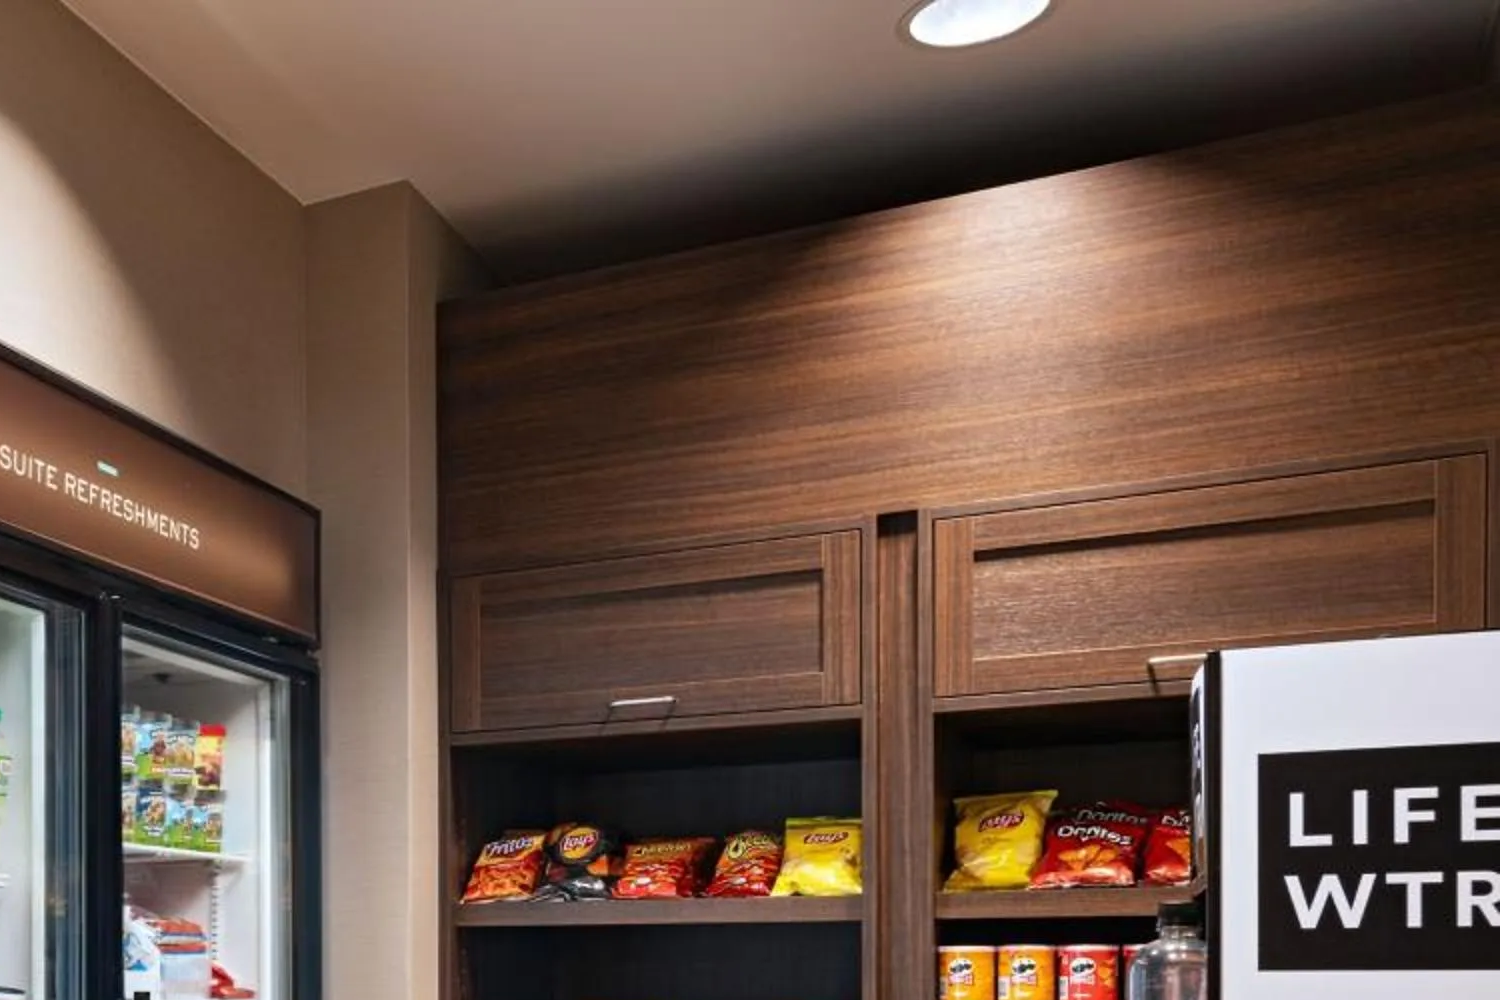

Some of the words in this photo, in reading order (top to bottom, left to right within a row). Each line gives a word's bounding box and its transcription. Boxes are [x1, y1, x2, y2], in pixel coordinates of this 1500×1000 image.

[0, 444, 58, 490] SUITE
[64, 472, 200, 550] REFRESHMENTS
[1057, 824, 1134, 847] Doritos
[1288, 783, 1500, 848] LIFE
[1283, 870, 1500, 929] WTR
